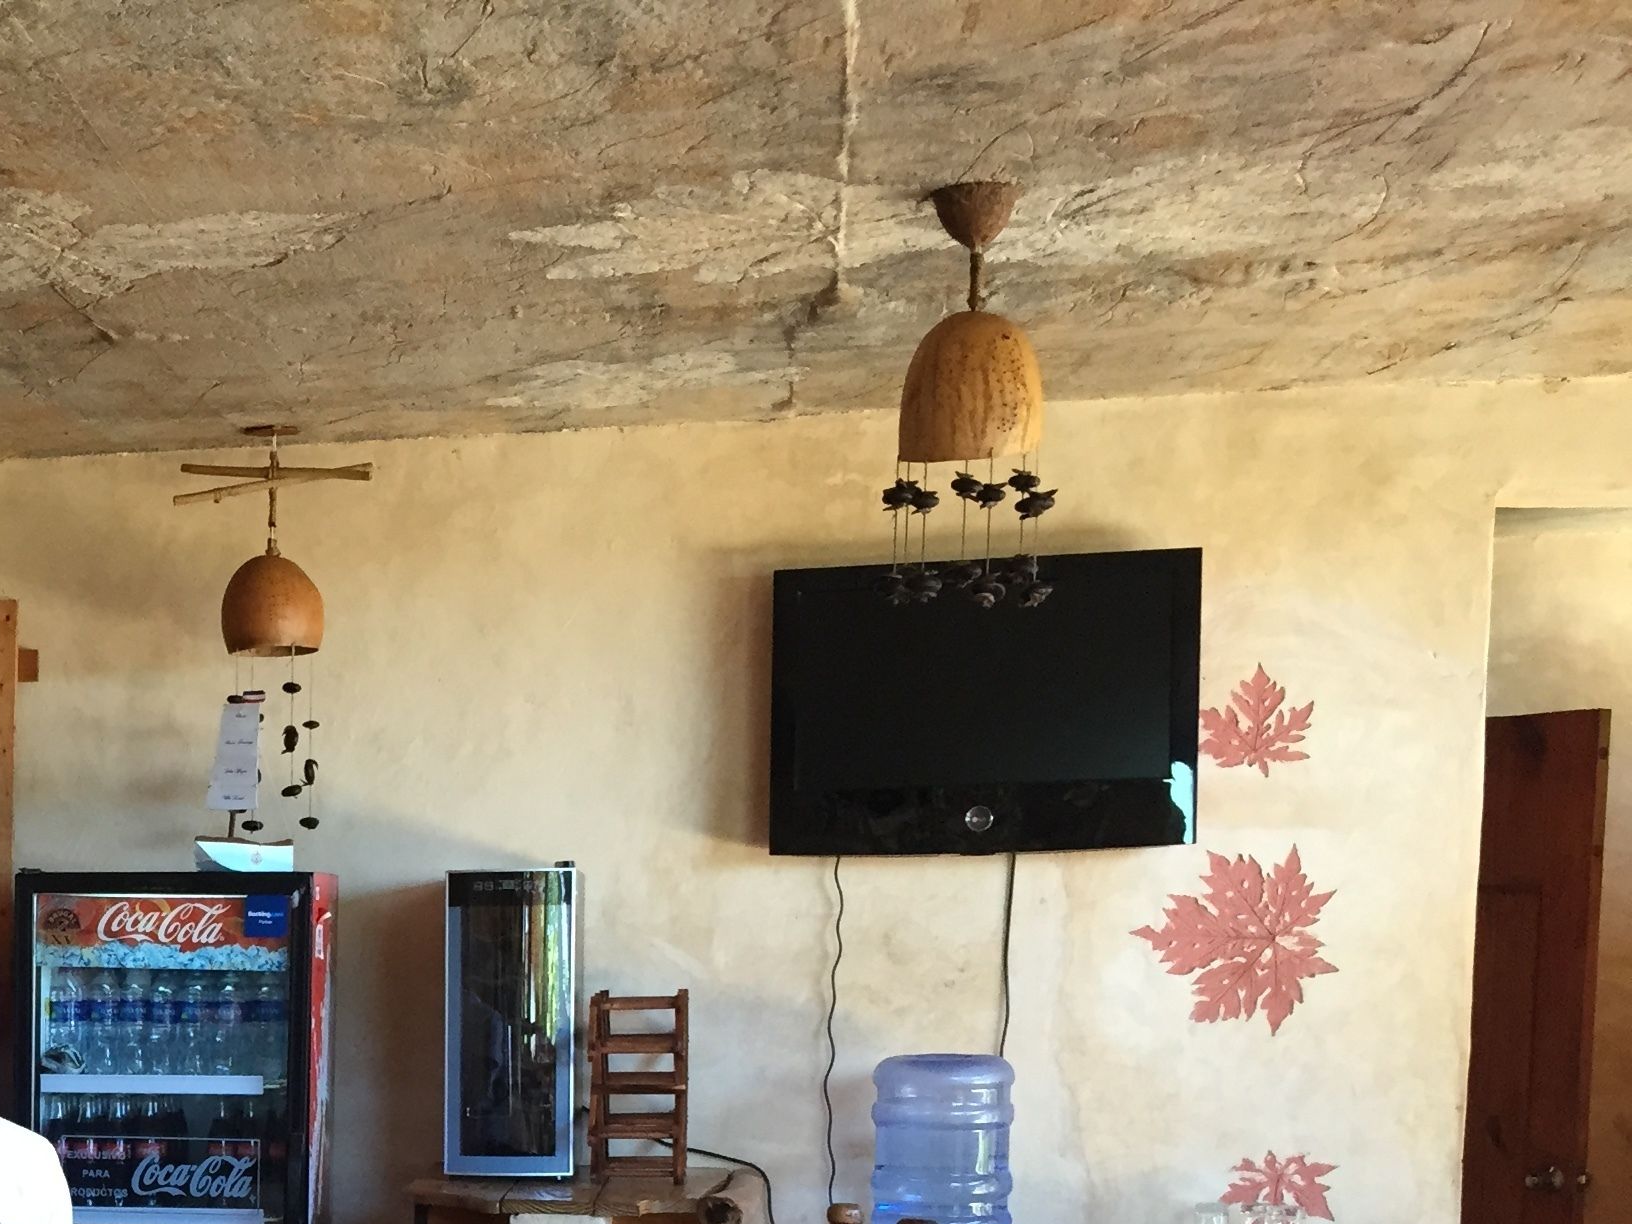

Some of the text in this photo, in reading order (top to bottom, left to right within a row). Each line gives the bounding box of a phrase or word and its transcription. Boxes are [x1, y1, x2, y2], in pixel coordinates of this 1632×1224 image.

[97, 901, 231, 944] Coca-Cola
[66, 1149, 126, 1160] EXCLUSIVO
[82, 1169, 110, 1178] PARA
[131, 1153, 256, 1198] Coca-Cola
[70, 1187, 128, 1198] RODUCTOS
